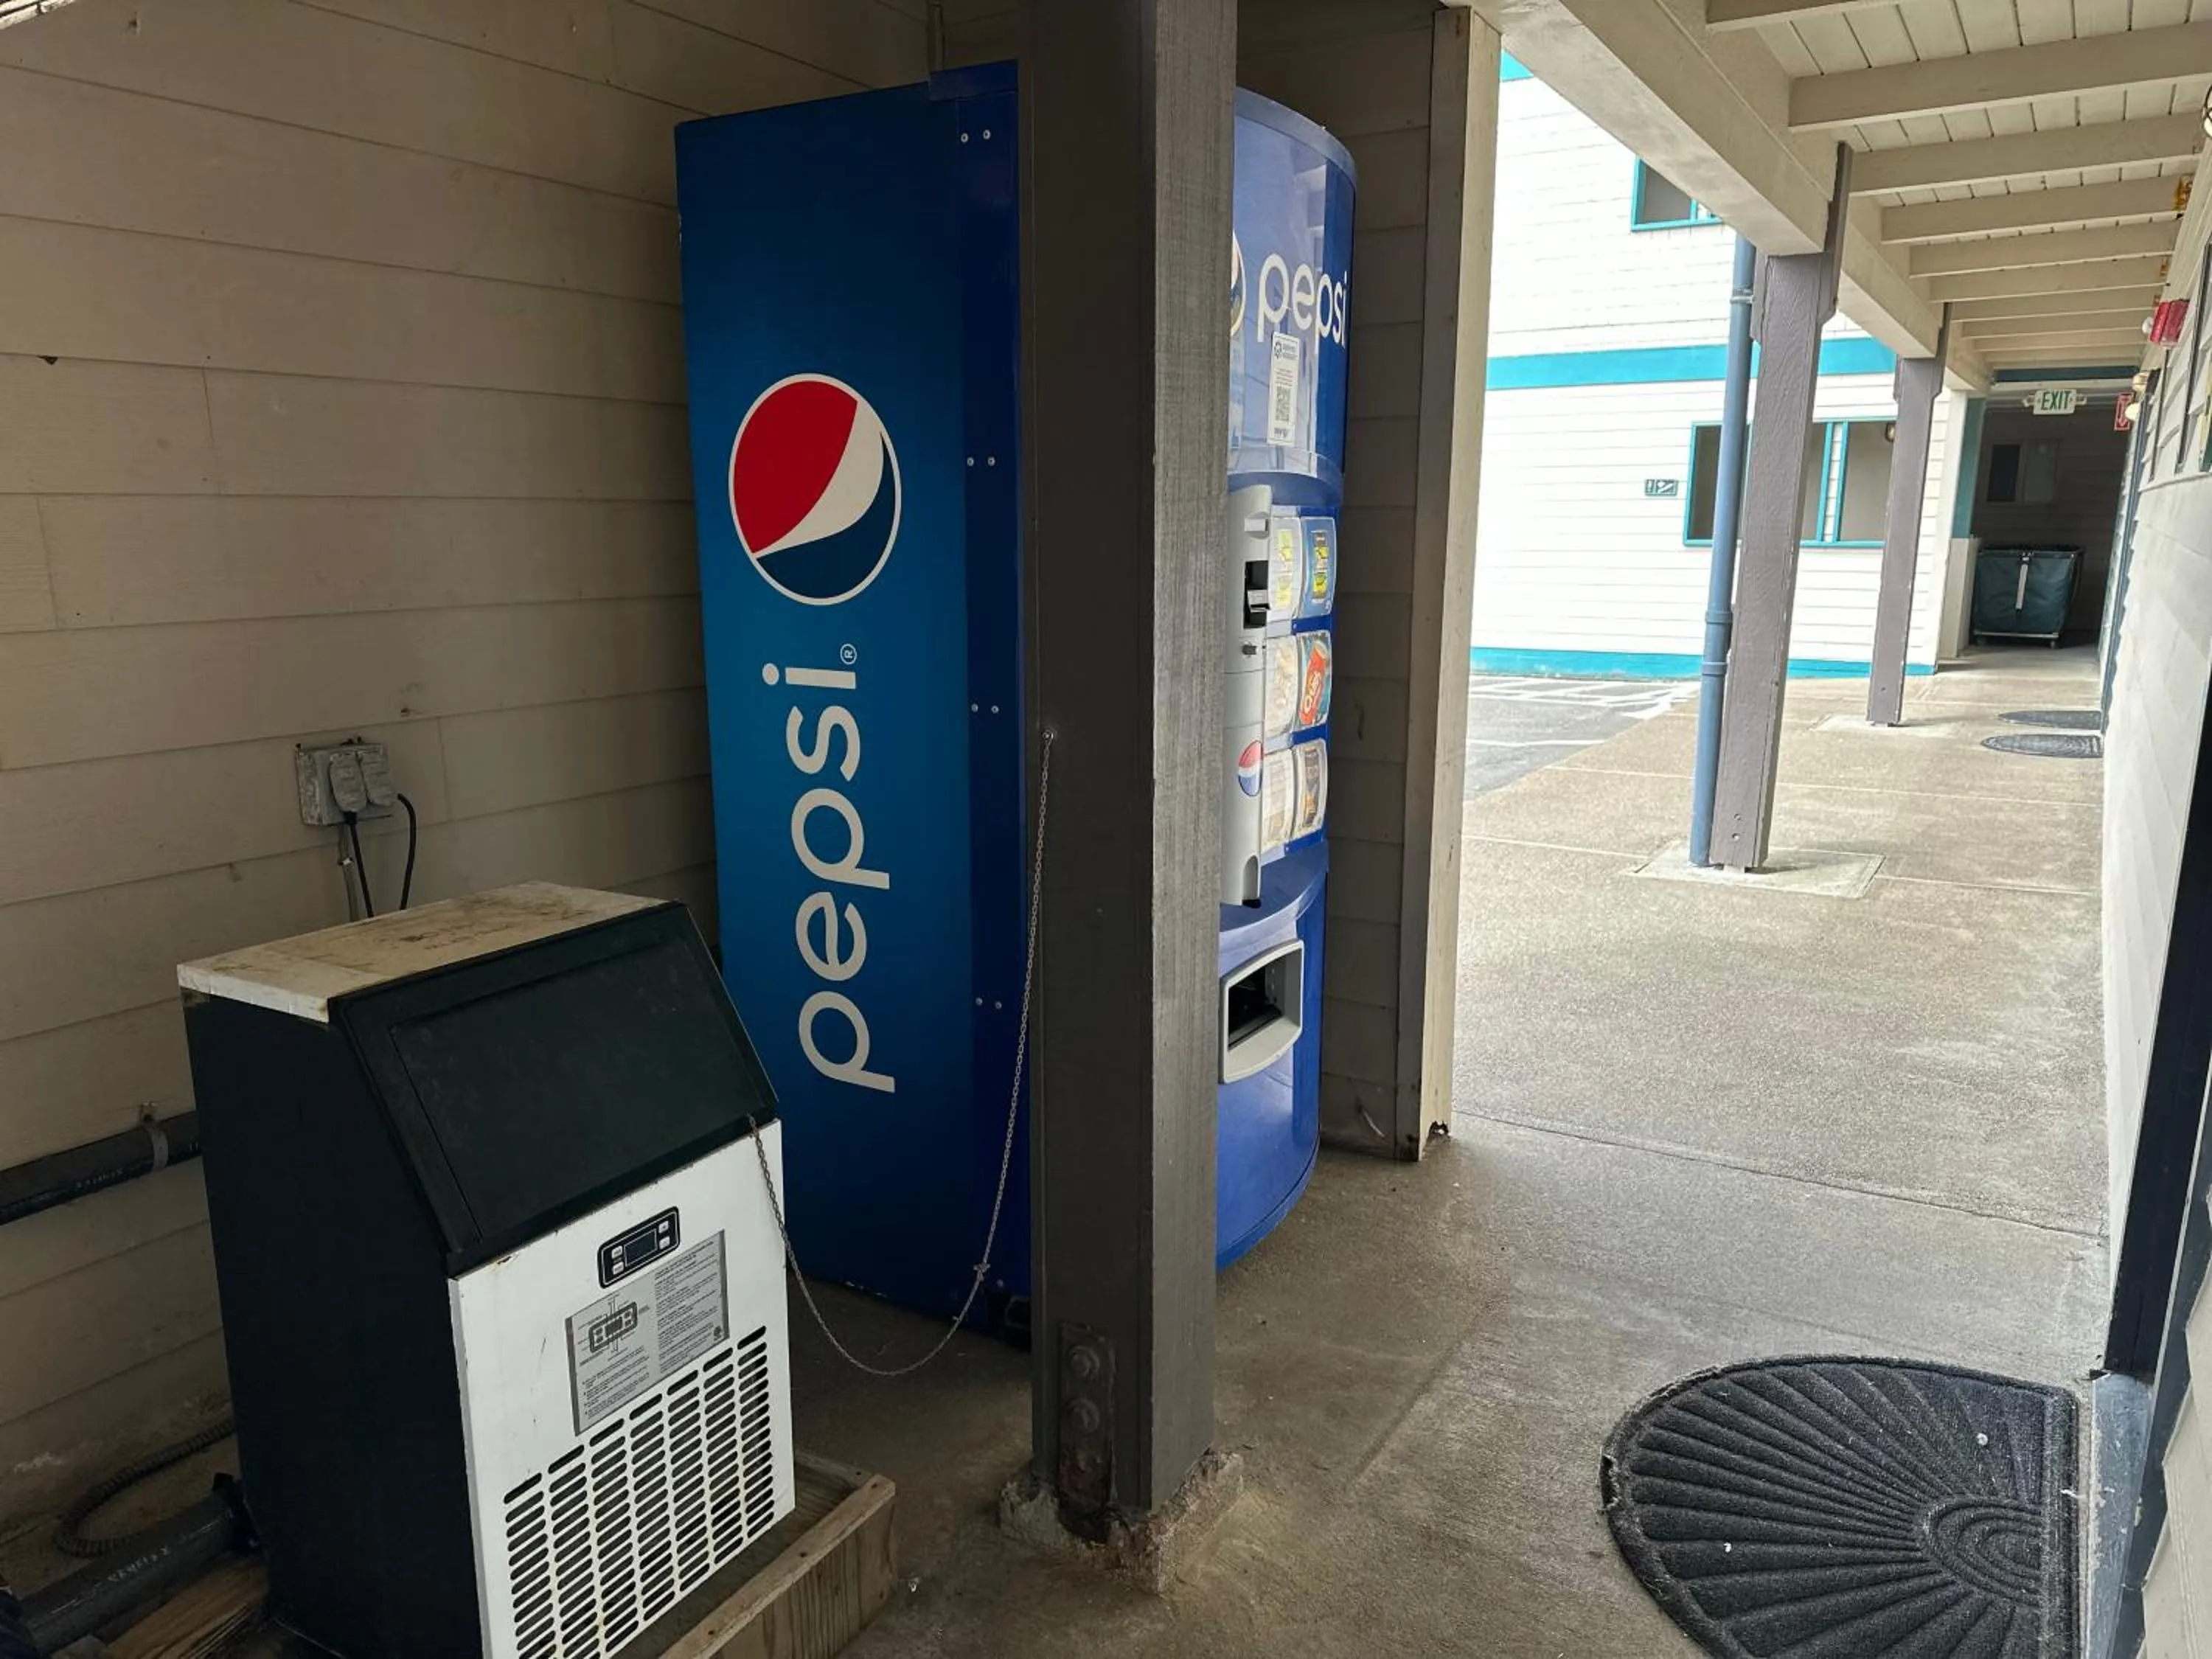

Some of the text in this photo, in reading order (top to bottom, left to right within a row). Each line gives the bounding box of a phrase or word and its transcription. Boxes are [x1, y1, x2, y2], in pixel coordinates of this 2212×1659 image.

[1257, 253, 1347, 354] pepsi
[2041, 391, 2070, 410] EXIT
[762, 663, 895, 1093] pepsi
